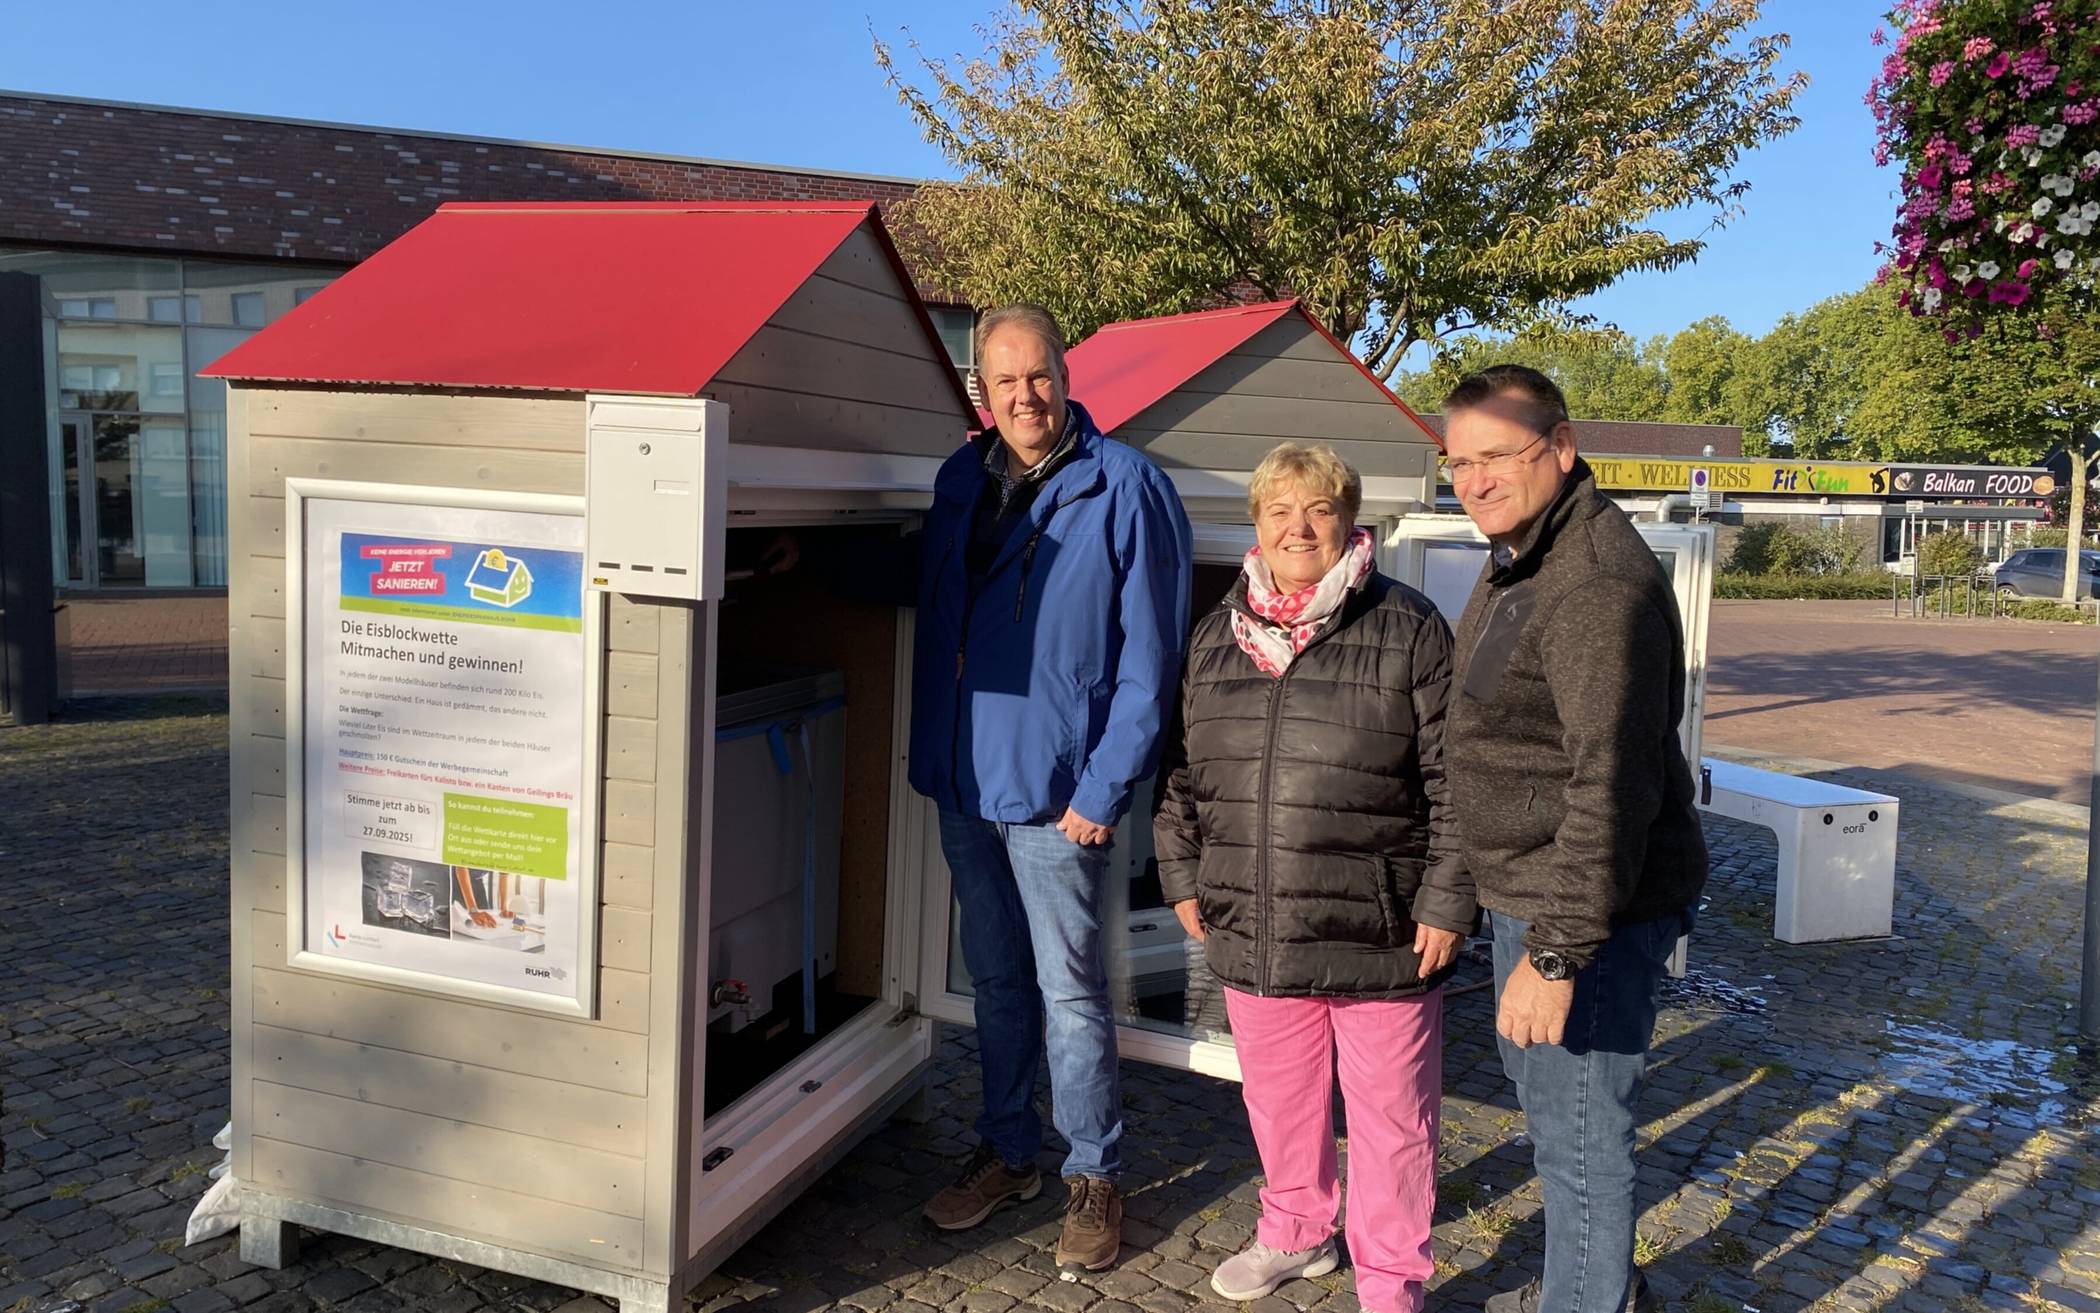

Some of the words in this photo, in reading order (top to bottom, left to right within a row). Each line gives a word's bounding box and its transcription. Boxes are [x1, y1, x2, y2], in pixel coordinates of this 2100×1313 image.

[1640, 463, 1750, 487] WELESS
[1773, 469, 1798, 490] Fit
[1816, 470, 1849, 492] Fun
[1923, 472, 1976, 493] Balkan
[1985, 474, 2033, 494] FOOD
[389, 561, 424, 572] JETZT
[377, 579, 438, 590] SANIEREN!
[341, 620, 362, 634] Die
[367, 623, 459, 645] Eisblockwette
[341, 641, 415, 662] Mitmachen
[419, 652, 445, 665] und
[449, 656, 523, 674] gewinnen!
[471, 685, 484, 694] sich
[485, 687, 502, 696] rund
[503, 688, 517, 697] 200
[518, 690, 531, 698] Kilo
[426, 698, 442, 706] Haus
[489, 705, 500, 713] das
[376, 753, 388, 761] 150
[394, 756, 426, 767] Gutschein
[427, 759, 439, 768] der
[440, 761, 509, 777] Werbegemeinschaft
[347, 794, 380, 808] Stimme
[382, 799, 402, 811] jetzt
[404, 803, 415, 812] ab
[417, 805, 431, 815] bis
[448, 800, 456, 808] So
[378, 816, 397, 825] zum
[363, 826, 413, 842] 27.09.2025!
[525, 968, 550, 979] RUHR
